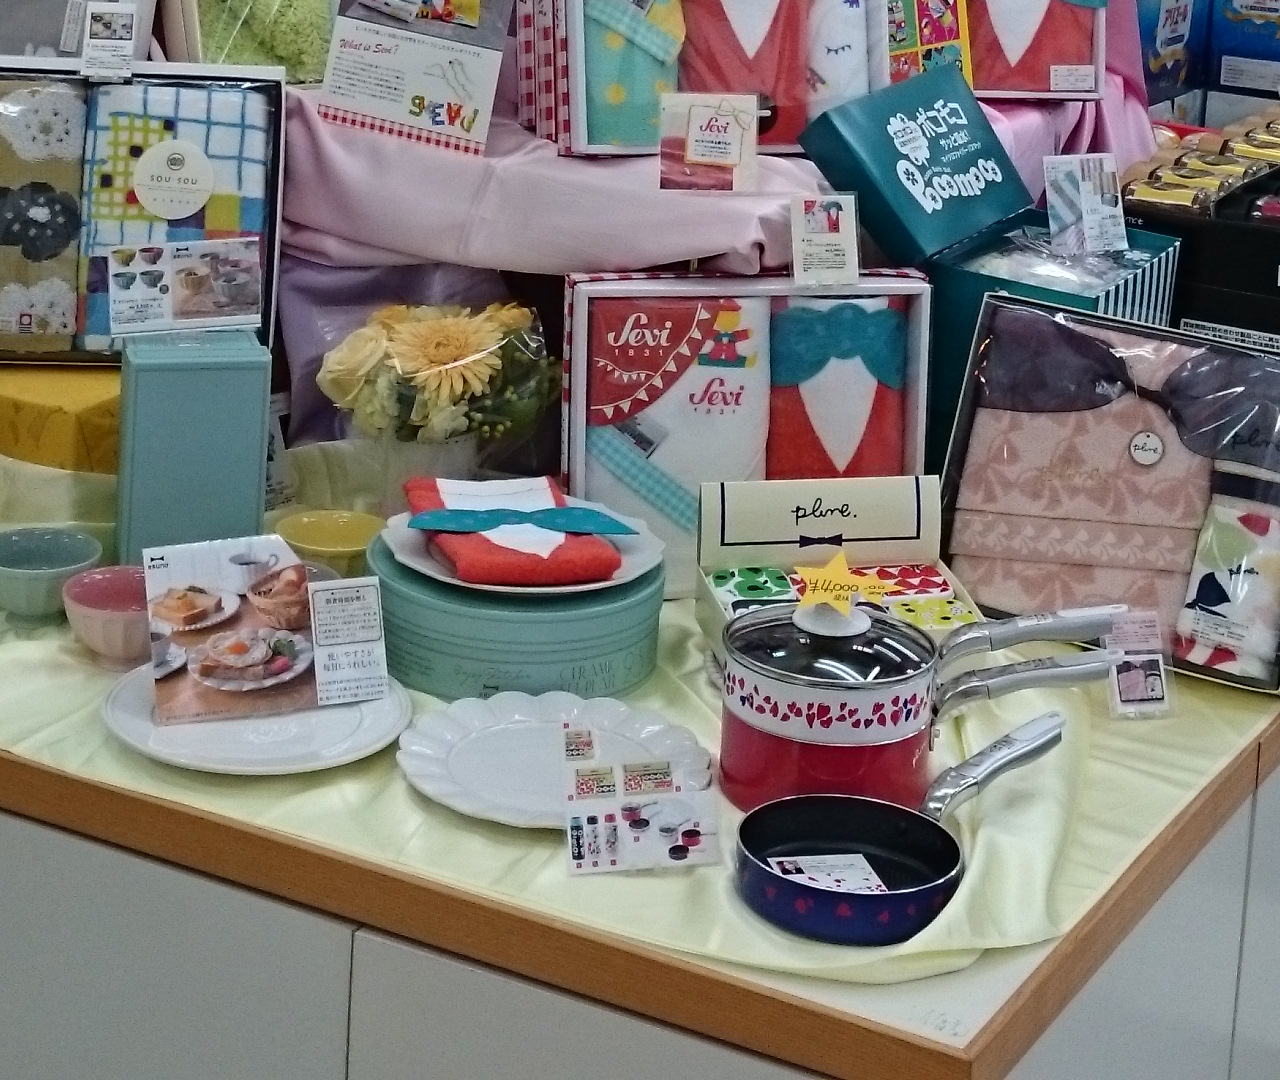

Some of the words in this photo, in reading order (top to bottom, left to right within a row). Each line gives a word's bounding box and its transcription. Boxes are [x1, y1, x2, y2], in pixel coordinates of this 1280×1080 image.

[699, 116, 730, 134] Sevi
[608, 313, 671, 347] Sevi
[614, 348, 665, 357] 1831
[688, 377, 745, 407] Sevi
